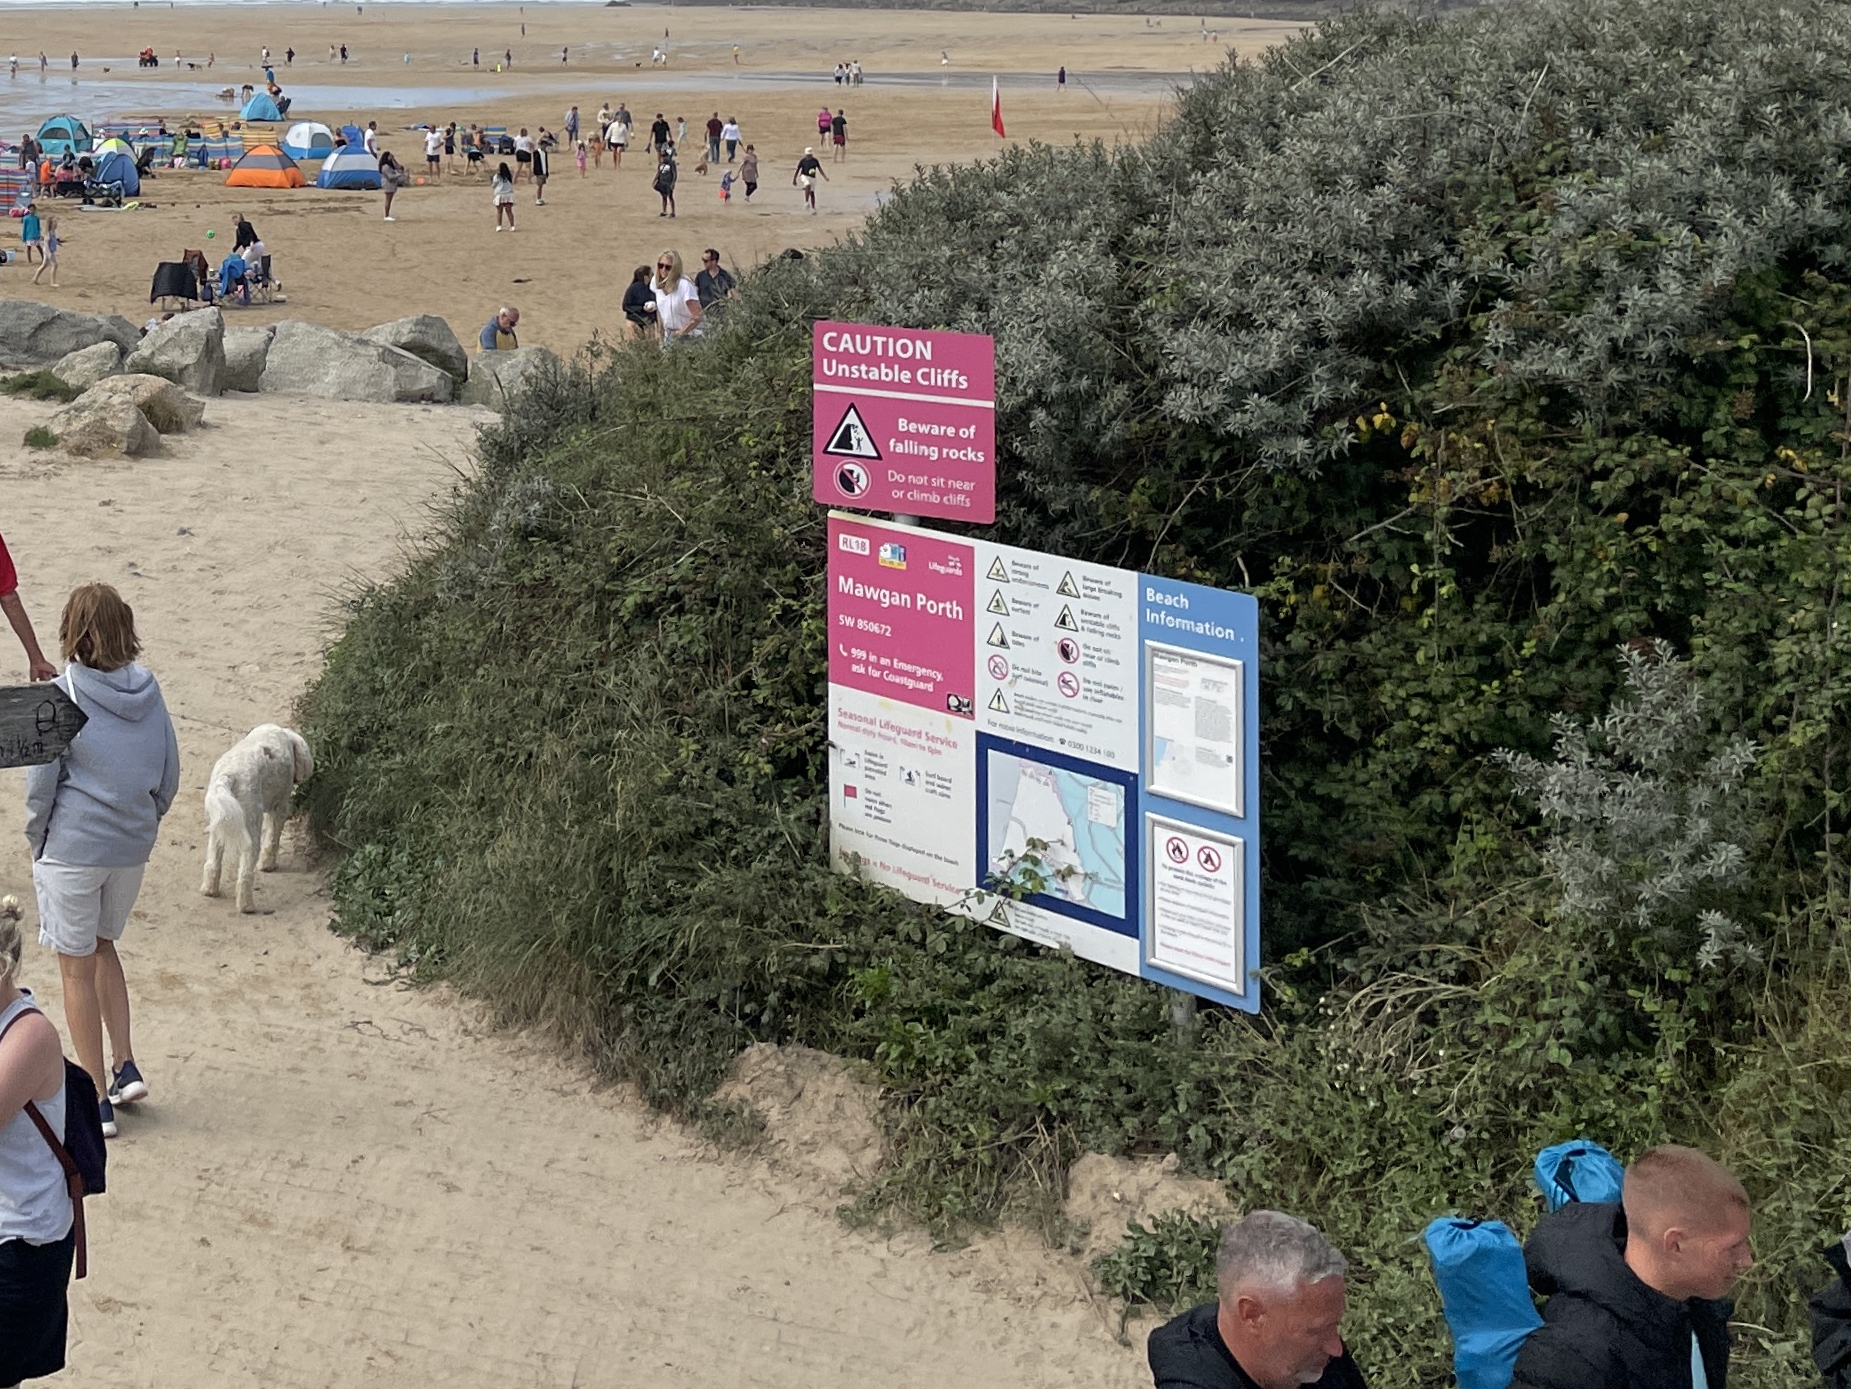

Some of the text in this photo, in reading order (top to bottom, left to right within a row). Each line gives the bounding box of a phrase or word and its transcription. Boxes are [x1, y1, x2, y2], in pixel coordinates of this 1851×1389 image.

[822, 331, 932, 360] CAUTION
[822, 358, 968, 390] Unstable Cliffs
[898, 417, 976, 439] Beware of
[889, 438, 985, 462] falling rocks
[888, 470, 976, 491] Do not sit near
[892, 490, 971, 507] or climb cliffs
[842, 536, 867, 552] RL18
[838, 575, 963, 620] Mawgan Porth
[1146, 587, 1189, 610] Beach
[839, 614, 892, 637] SW 850672
[1146, 608, 1235, 642] Information
[851, 648, 867, 660] 999
[869, 651, 878, 663] in
[880, 656, 891, 667] an
[851, 663, 934, 692] ask for Coastguard
[837, 707, 958, 749] Seasonal Lifeguard Service
[879, 860, 891, 872] No
